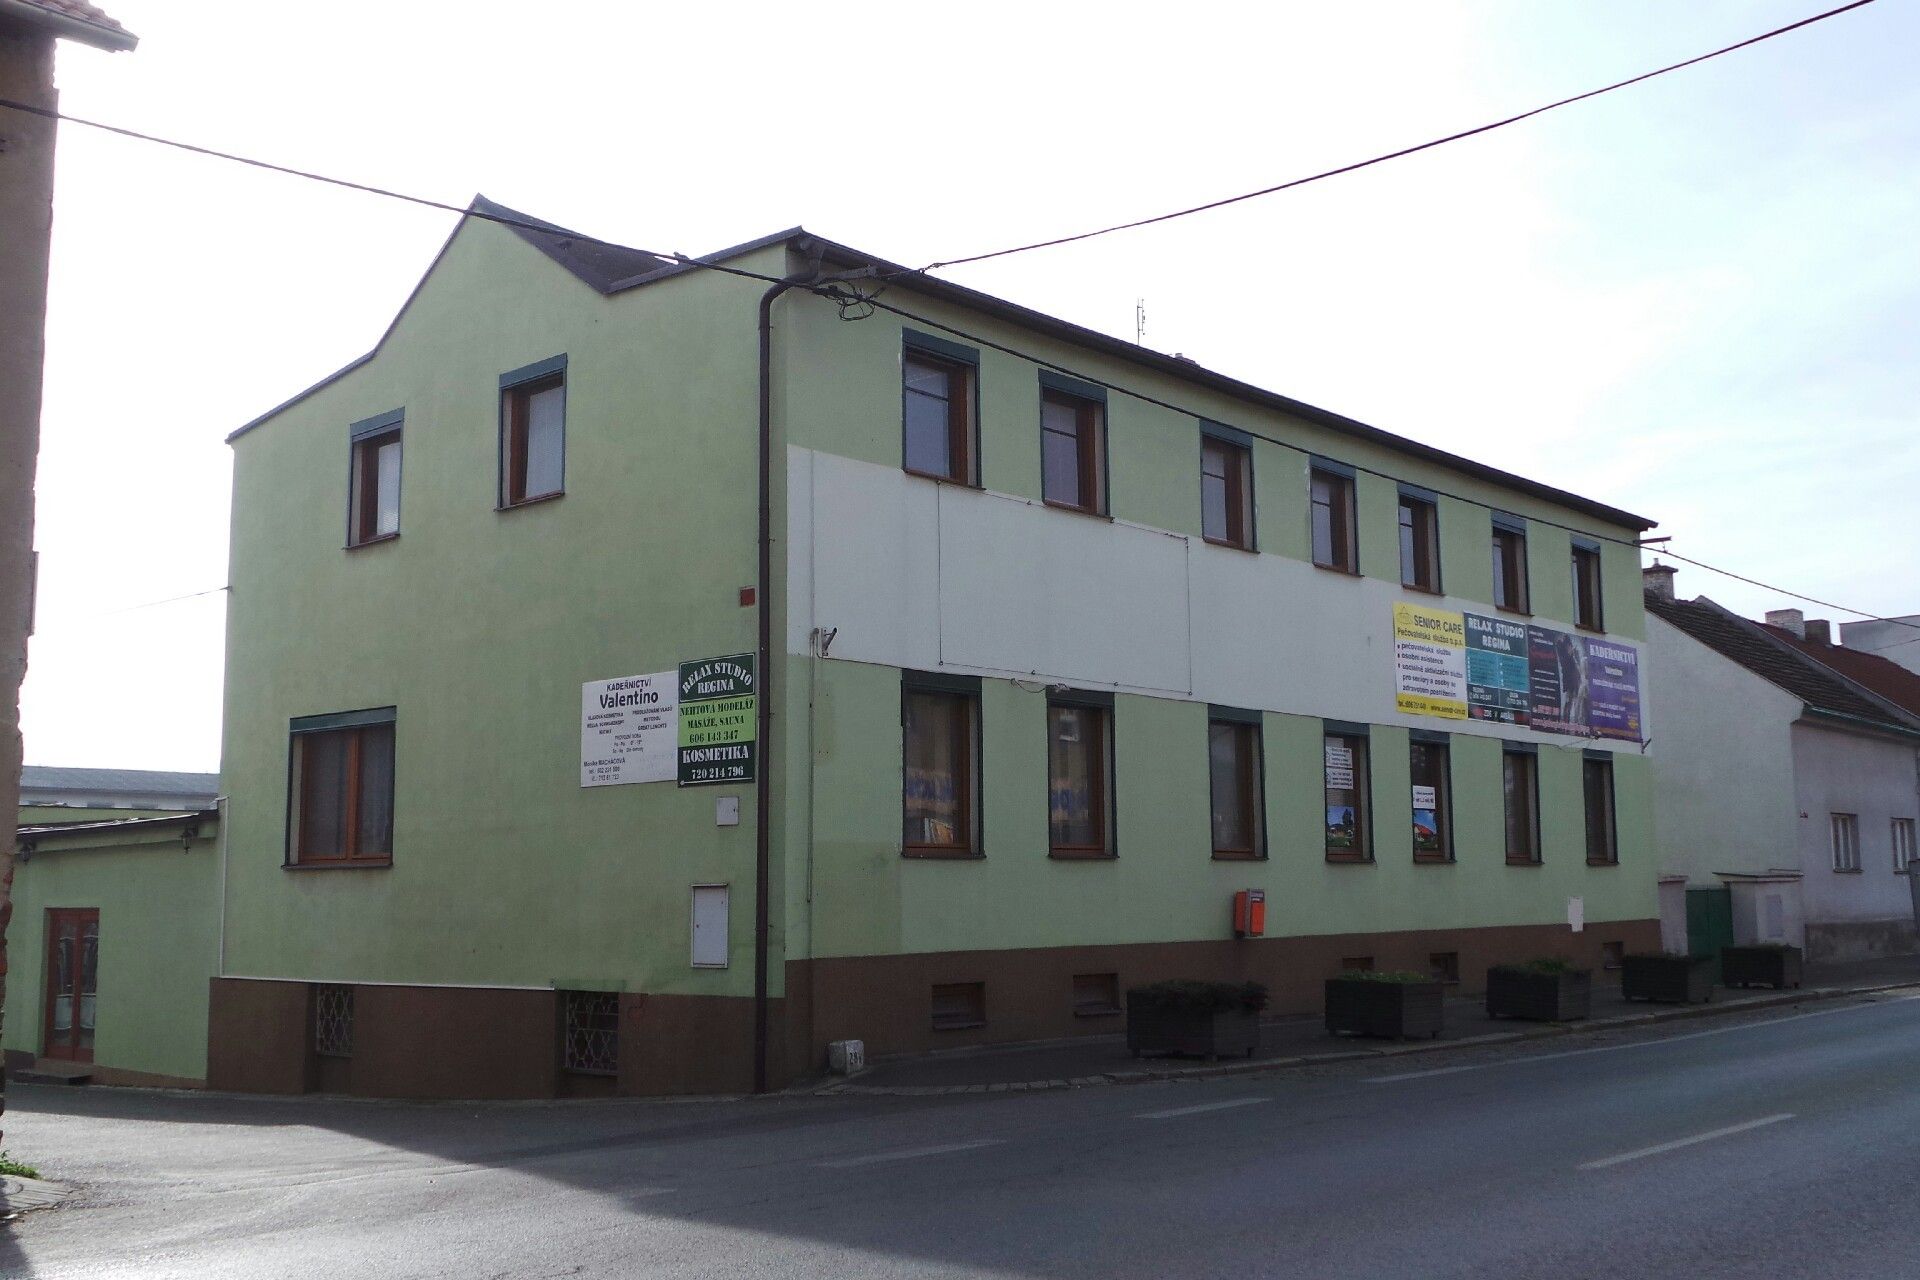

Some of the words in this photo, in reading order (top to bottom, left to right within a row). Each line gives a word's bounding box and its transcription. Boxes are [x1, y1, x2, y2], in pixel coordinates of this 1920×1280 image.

[1414, 615, 1441, 630] SENIOR
[1443, 621, 1463, 635] CARE
[1468, 617, 1493, 633] RELAX
[1496, 622, 1524, 639] STUDIO
[1482, 634, 1511, 651] REGINA
[682, 664, 712, 694] RELAX
[715, 662, 752, 686] STUDIO
[698, 678, 734, 694] REGINA
[599, 688, 658, 709] Valentino
[719, 715, 744, 726] SAUNA
[689, 733, 704, 743] 606
[707, 731, 721, 742] 143
[723, 729, 738, 741] 347
[682, 745, 749, 763] KOSMETIKA
[691, 769, 707, 780] 720
[709, 767, 725, 778] 214
[727, 766, 744, 777] 796
